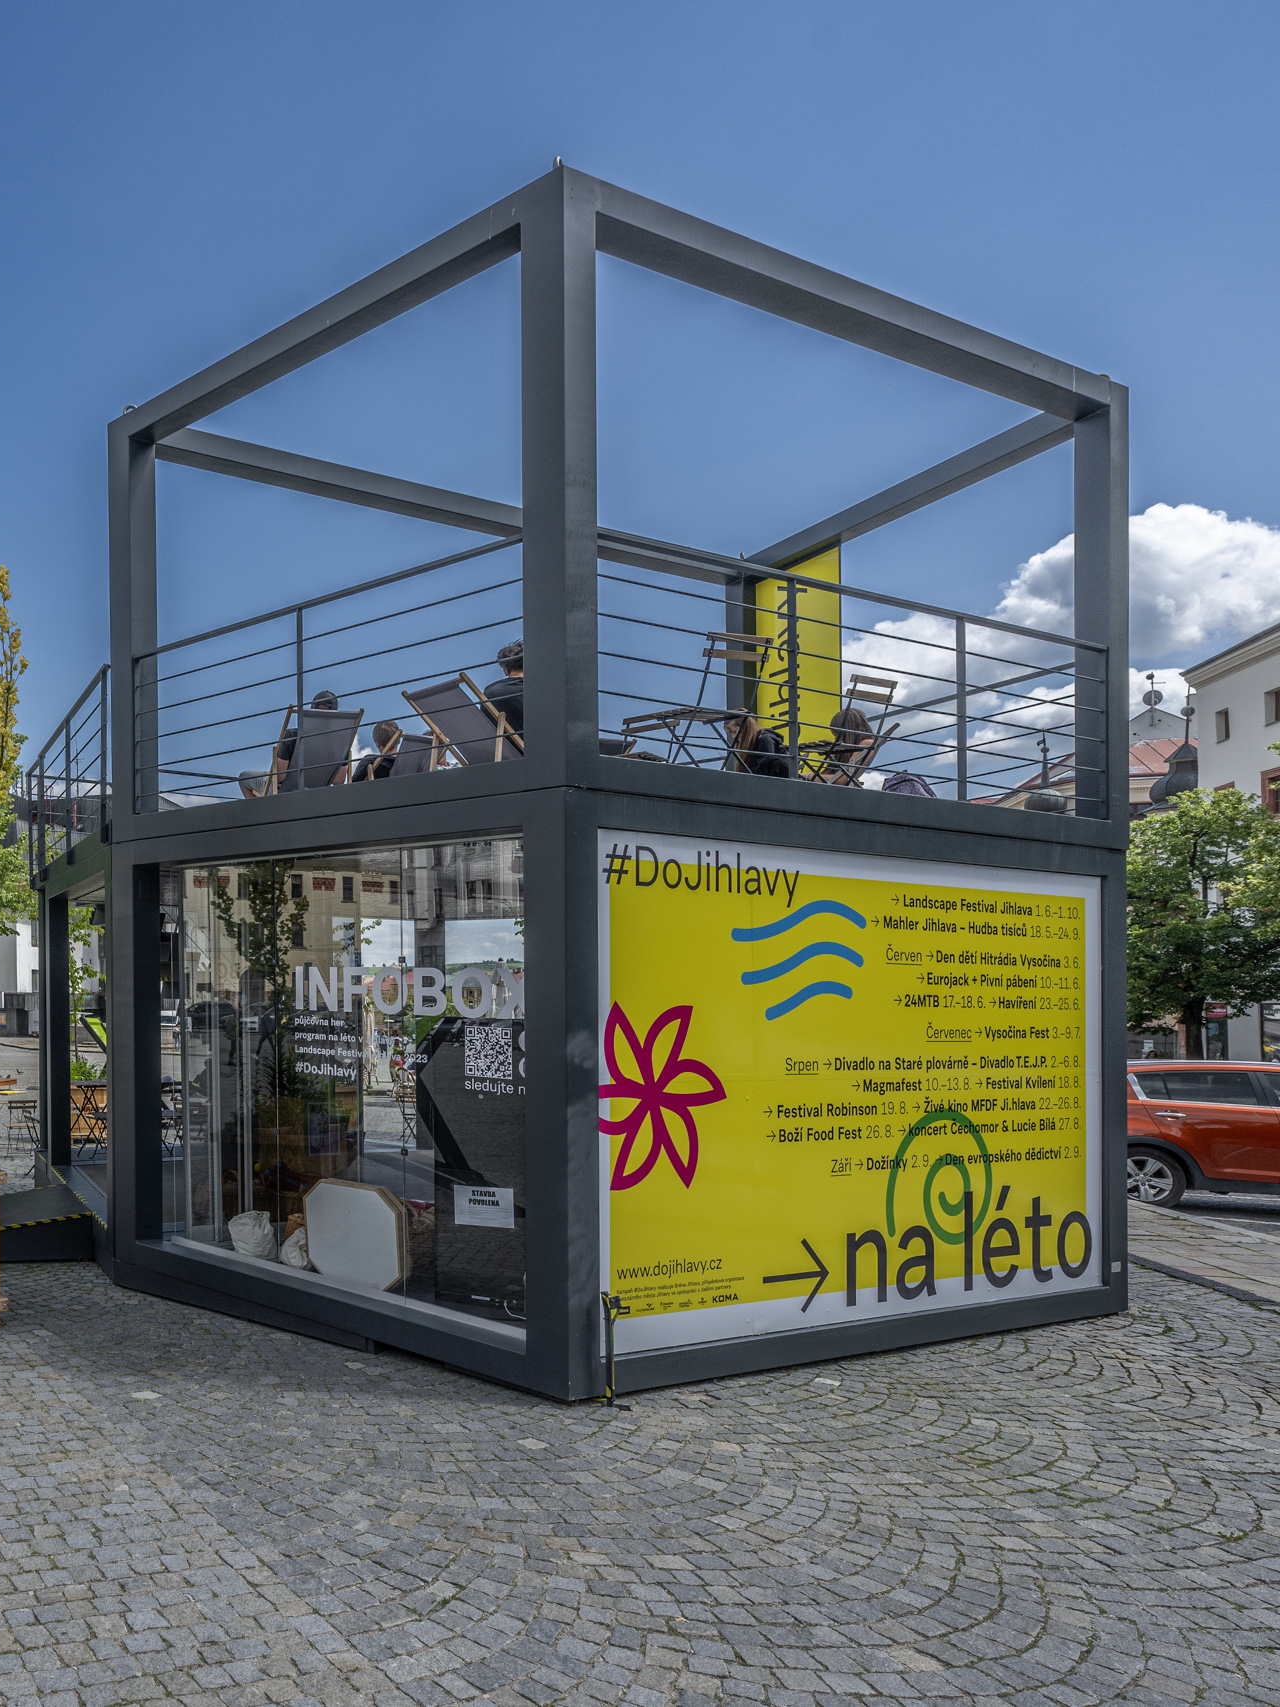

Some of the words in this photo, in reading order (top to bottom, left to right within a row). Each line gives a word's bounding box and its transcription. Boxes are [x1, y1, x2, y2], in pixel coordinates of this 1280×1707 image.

[602, 843, 800, 908] #DoJihlavy
[903, 894, 958, 914] Landscape
[960, 898, 997, 914] Festival
[1000, 901, 1033, 916] Jihlava
[883, 915, 920, 931] Mahler
[922, 918, 957, 933] Jihlava
[968, 921, 998, 936] Hudba
[1001, 922, 1027, 937] tisíců
[886, 943, 922, 962] Červen
[936, 950, 956, 964] Den
[958, 950, 978, 965] dětí
[980, 952, 1017, 967] Hitrádia
[1020, 953, 1061, 970] Vysočina
[927, 972, 970, 989] Eurojack
[980, 973, 1004, 988] Pivní
[1006, 974, 1038, 990] pábení
[295, 965, 525, 1019] INFOBOX
[904, 994, 940, 1008] 24MTB
[998, 996, 1037, 1010] Havíření
[294, 1015, 329, 1027] půjčovna
[331, 1017, 345, 1027] her
[294, 1032, 327, 1041] program
[340, 1033, 356, 1043] léto
[926, 1022, 972, 1039] Červenec
[984, 1025, 1027, 1042] Vysočina
[1029, 1026, 1050, 1039] Fest
[294, 1044, 336, 1056] Landscape
[403, 1053, 428, 1064] 2023
[295, 1061, 357, 1081] #DoJihlavy
[785, 1057, 819, 1075] Srpen
[834, 1056, 875, 1071] Divadlo
[878, 1059, 892, 1071] na
[894, 1055, 923, 1070] Staré
[926, 1055, 969, 1073] plovárně
[979, 1056, 1015, 1069] Divadlo
[1016, 1056, 1048, 1069] T.E.J.P.
[464, 1078, 514, 1096] sledujte
[863, 1077, 923, 1096] Magmafest
[985, 1076, 1023, 1090] Festival
[1025, 1075, 1056, 1089] Kvílení
[777, 1102, 823, 1119] Festival
[826, 1101, 878, 1117] Robinson
[923, 1096, 946, 1114] Živé
[947, 1098, 969, 1113] kino
[971, 1098, 998, 1113] MFDF
[1000, 1097, 1036, 1112] Ji.hlava
[778, 1126, 803, 1143] Boží
[806, 1126, 835, 1142] Food
[838, 1125, 863, 1141] Fest
[908, 1122, 948, 1137] koncert
[950, 1117, 999, 1135] Čechomor
[1001, 1120, 1009, 1133] &
[1011, 1118, 1037, 1133] Lucie
[1039, 1118, 1056, 1131] Bílá
[831, 1157, 852, 1174] Září
[866, 1154, 908, 1172] Dožínky
[945, 1152, 965, 1167] Den
[967, 1148, 1022, 1167] evropského
[1024, 1145, 1062, 1161] dědictví
[468, 1198, 500, 1207] POVOLENA
[471, 1190, 496, 1198] STAVBA
[846, 1224, 937, 1308] na
[963, 1185, 1093, 1292] léto
[616, 1258, 723, 1280] www.dojihlavy.cz
[712, 1293, 739, 1304] KOMA
